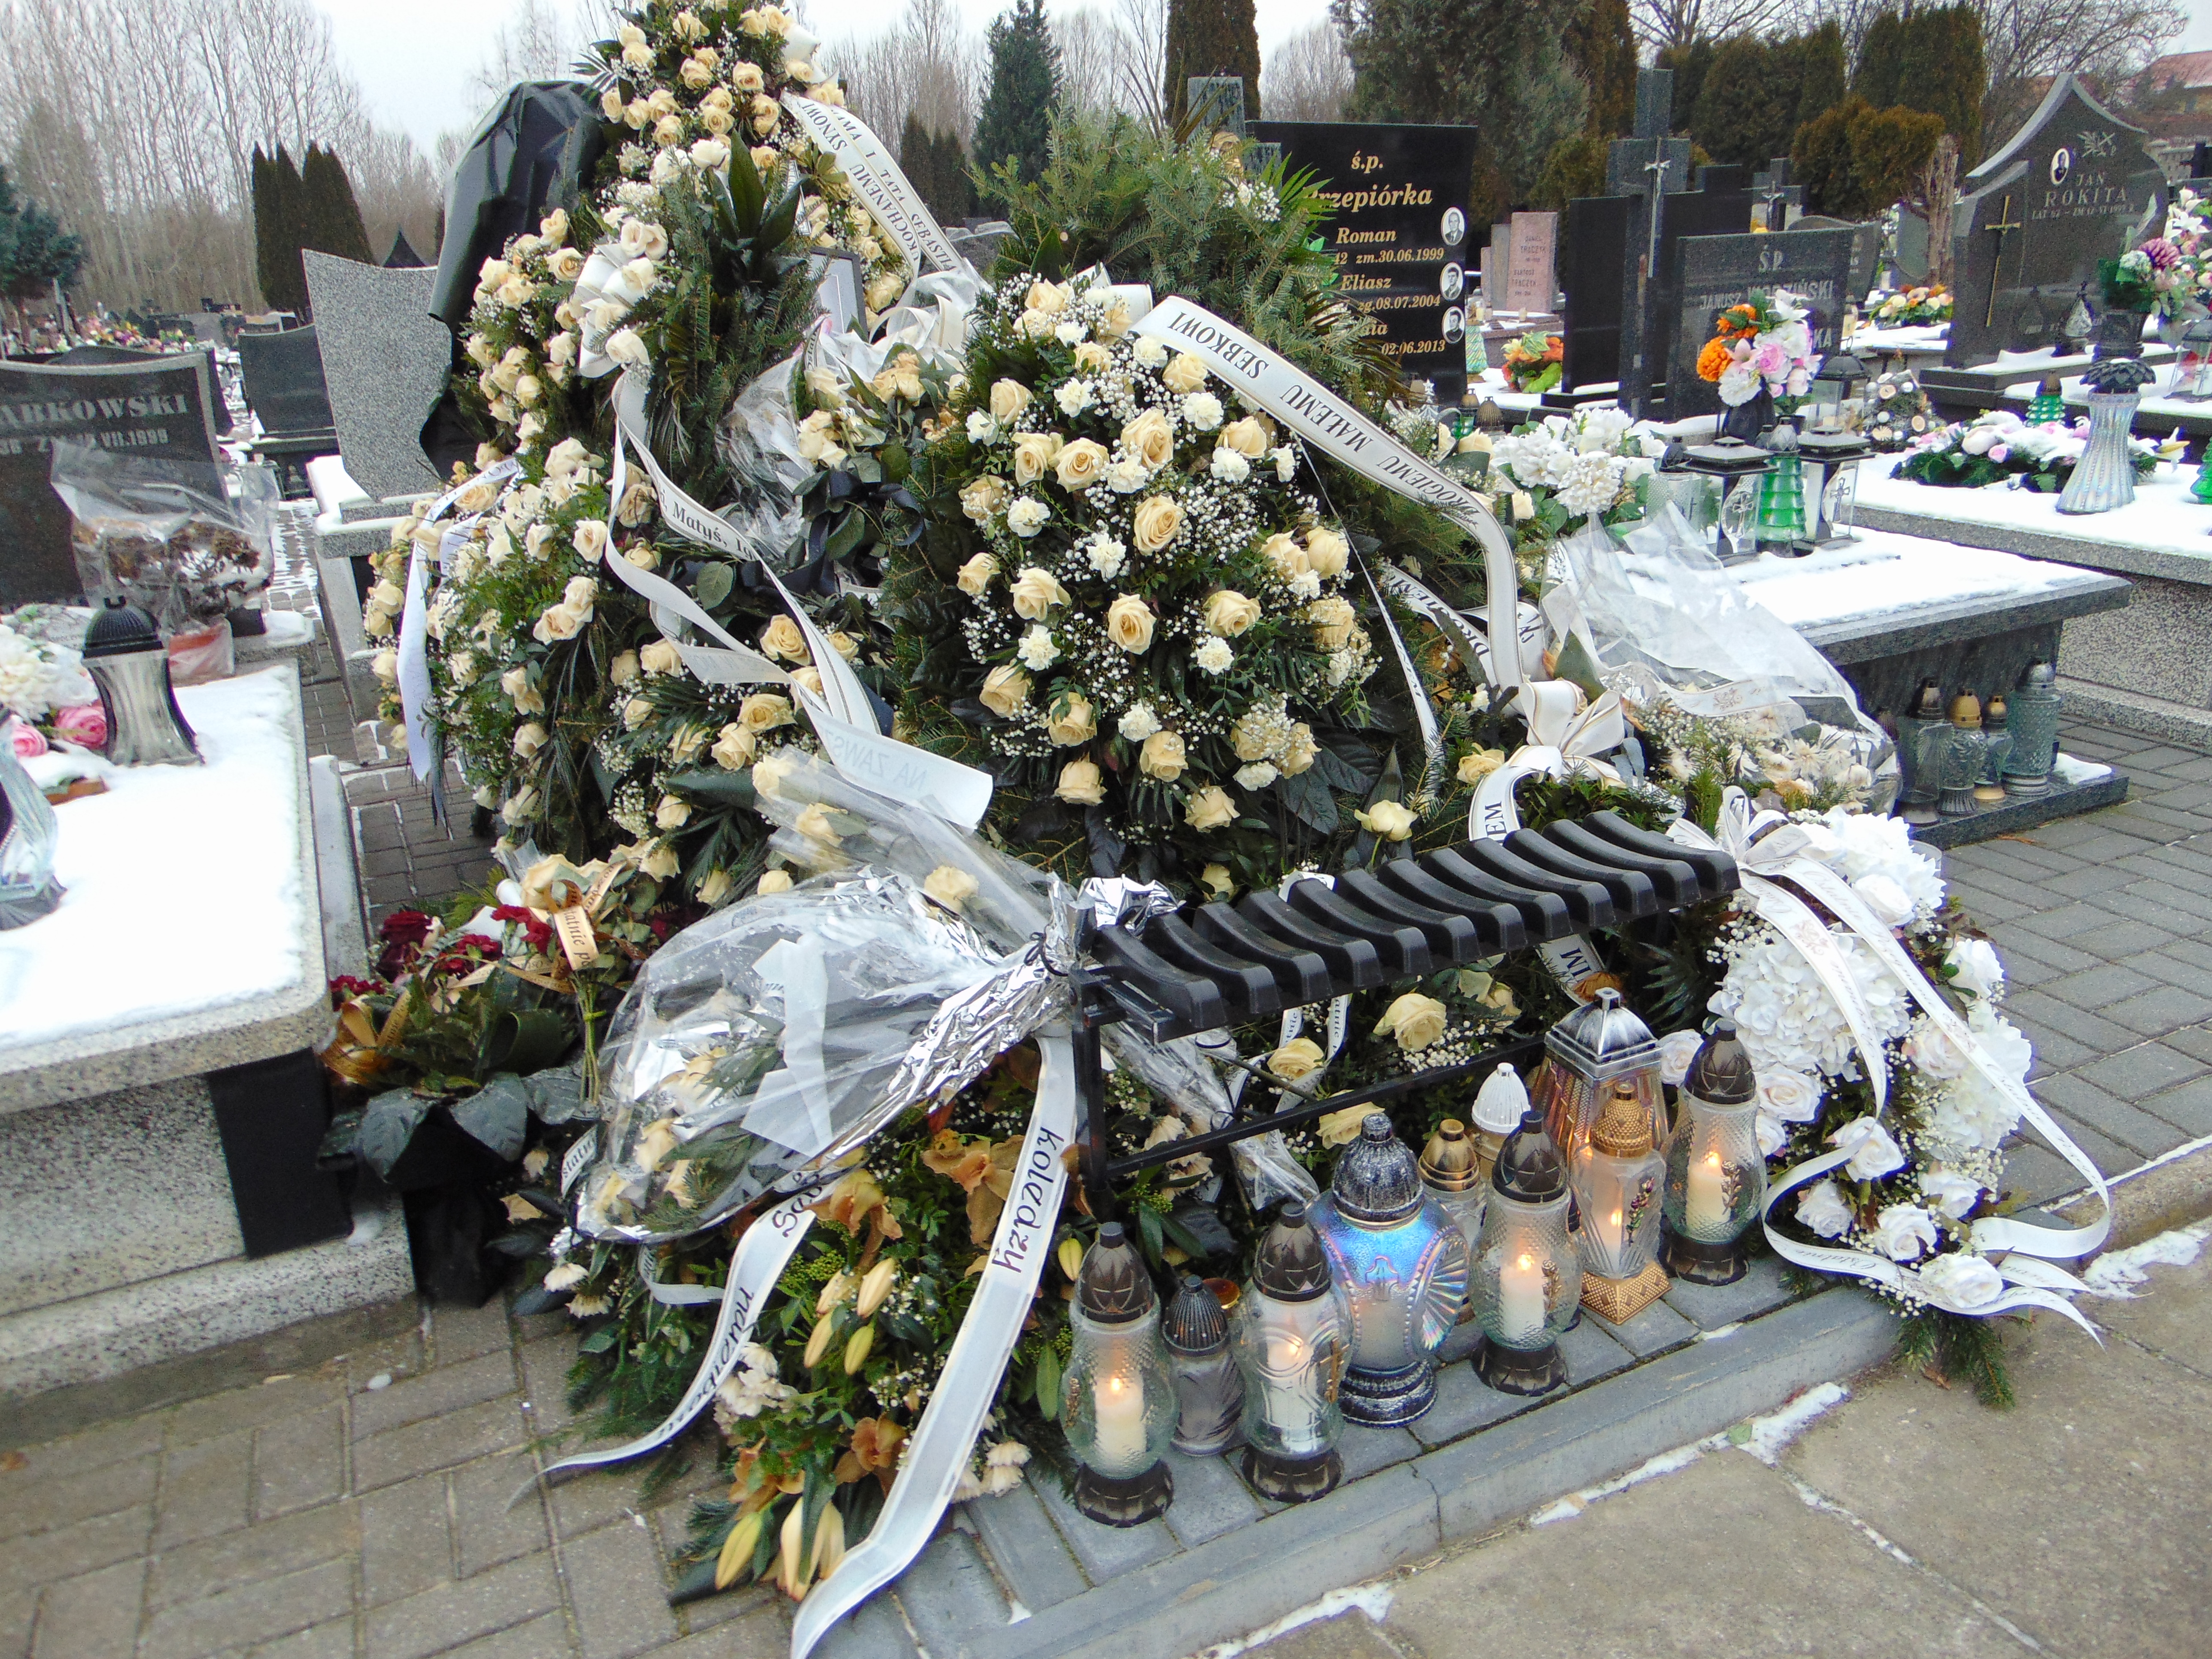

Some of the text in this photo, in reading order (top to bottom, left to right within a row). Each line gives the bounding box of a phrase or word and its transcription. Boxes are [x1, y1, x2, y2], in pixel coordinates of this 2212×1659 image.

[1351, 150, 1384, 173] ś.p.
[802, 103, 920, 261] UKOCHANEMU SYNOWI
[880, 169, 906, 201] TATA
[2075, 171, 2105, 186] JAN
[2045, 187, 2126, 207] ROKITA
[1335, 227, 1397, 244] Roman
[1355, 247, 1445, 264] zm.30.06.1999
[1340, 273, 1392, 291] Eliasz
[1357, 295, 1441, 313] zg.08.07.2004
[1167, 312, 1480, 515] DROGIEMU MAŁEMU SEBKOWI
[564, 911, 586, 946] tatnie
